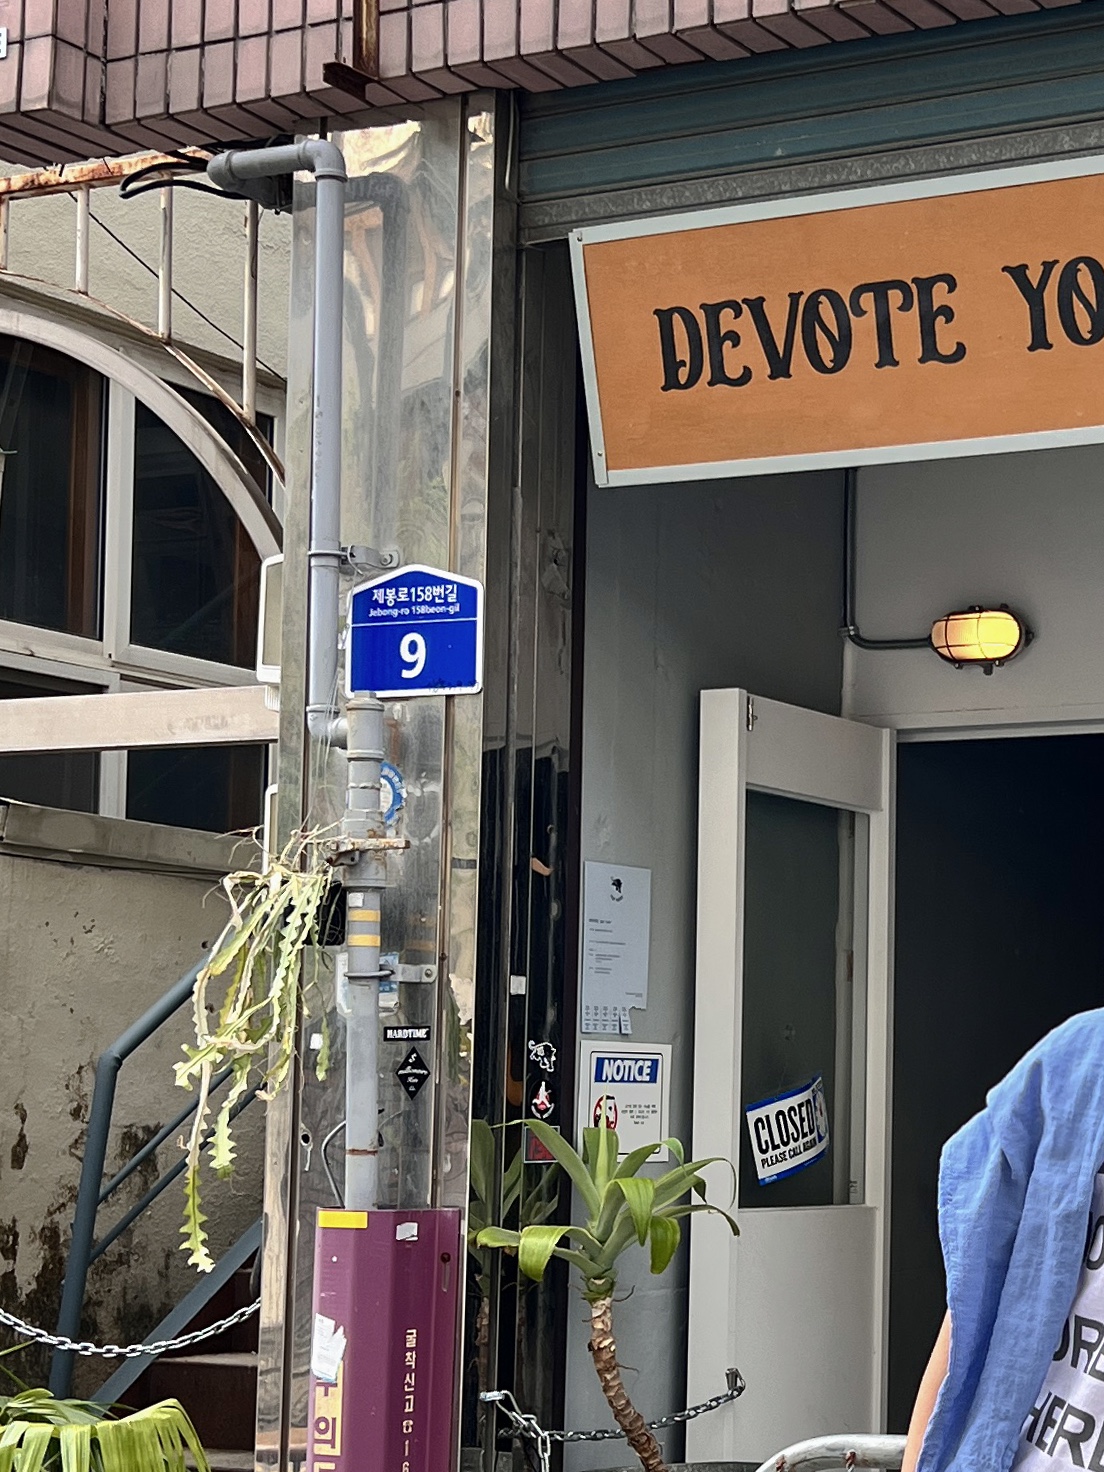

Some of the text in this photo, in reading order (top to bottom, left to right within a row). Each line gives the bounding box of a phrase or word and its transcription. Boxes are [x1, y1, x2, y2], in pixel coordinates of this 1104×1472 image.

[653, 273, 966, 393] DEVOTE
[368, 603, 460, 617] Jebong-ro 158beon-gil
[372, 583, 458, 606] 제봉로158번길
[399, 632, 427, 679] 9
[602, 1059, 652, 1082] NOTICE
[753, 1098, 815, 1155] CLOSED
[760, 1150, 788, 1169] PLEASE
[403, 1328, 417, 1414] 굴착신고
